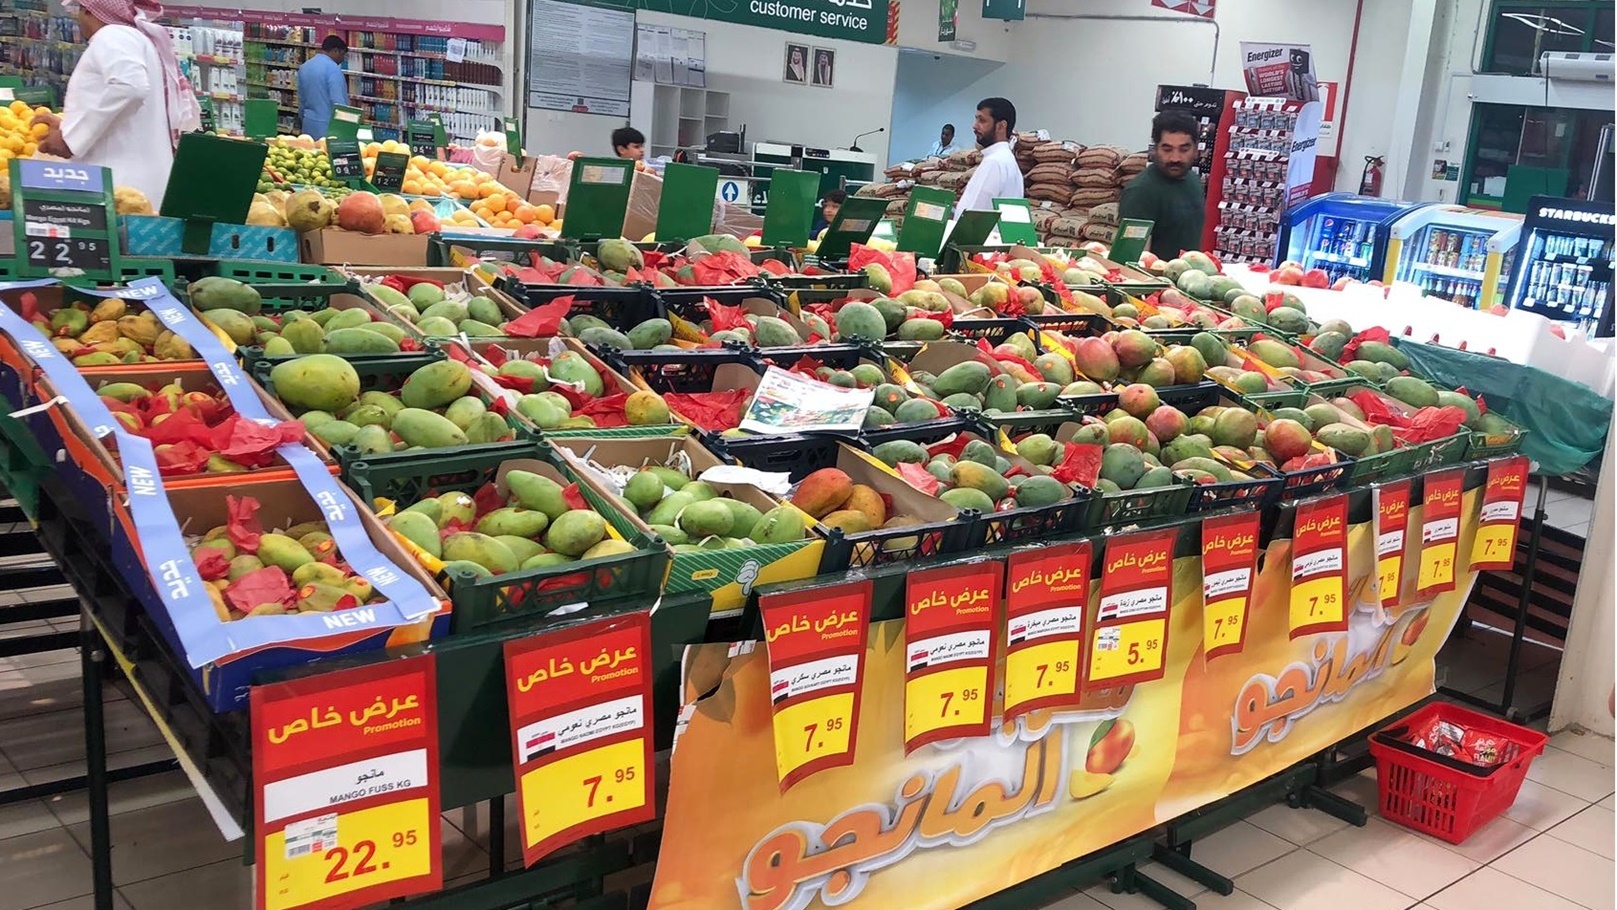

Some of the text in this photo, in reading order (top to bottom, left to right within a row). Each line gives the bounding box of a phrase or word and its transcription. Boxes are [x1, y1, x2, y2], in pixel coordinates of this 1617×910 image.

[750, 0, 815, 22] customer
[820, 11, 867, 30] service
[1247, 48, 1283, 63] Energizer
[1260, 75, 1283, 84] LONGEST
[1291, 137, 1317, 152] Energizer
[43, 167, 89, 185] جديد
[1539, 207, 1616, 226] STARBUCKS
[116, 283, 158, 299] NEW
[159, 308, 187, 325] NEW
[21, 340, 55, 359] NEW
[213, 361, 238, 386] جديد
[129, 465, 157, 496] NEW
[1426, 487, 1459, 504] عرض خاص
[317, 490, 345, 521] جديد
[1386, 500, 1404, 515] عرض
[1296, 516, 1340, 537] عرض خاص
[1203, 532, 1254, 555] عرض خاص
[1107, 549, 1166, 573] عرض خاص
[159, 559, 192, 600] جديد
[365, 566, 399, 587] NEW
[1012, 566, 1081, 593] عرض خاص
[1050, 584, 1081, 592] Promotion
[911, 587, 989, 615] عرض خاص
[956, 606, 989, 615] Promotion
[766, 610, 858, 642] عرض خاص
[821, 629, 857, 640] Promotion
[948, 642, 966, 651] مصري
[968, 638, 985, 648] مانجو
[517, 646, 637, 692] عرض خاص
[591, 667, 638, 683] Promotion
[811, 670, 831, 680] مصري
[833, 665, 851, 674] مانجو
[1233, 627, 1393, 752] المانجو
[268, 694, 420, 744] عرض خاص
[363, 717, 421, 736] Promotion
[557, 707, 637, 736] مانجو مصري نعومي
[561, 735, 579, 743] MANGO
[355, 768, 384, 785] مانجو
[329, 779, 411, 804] MANGO FUSS KG
[743, 725, 1064, 910] المانجو
